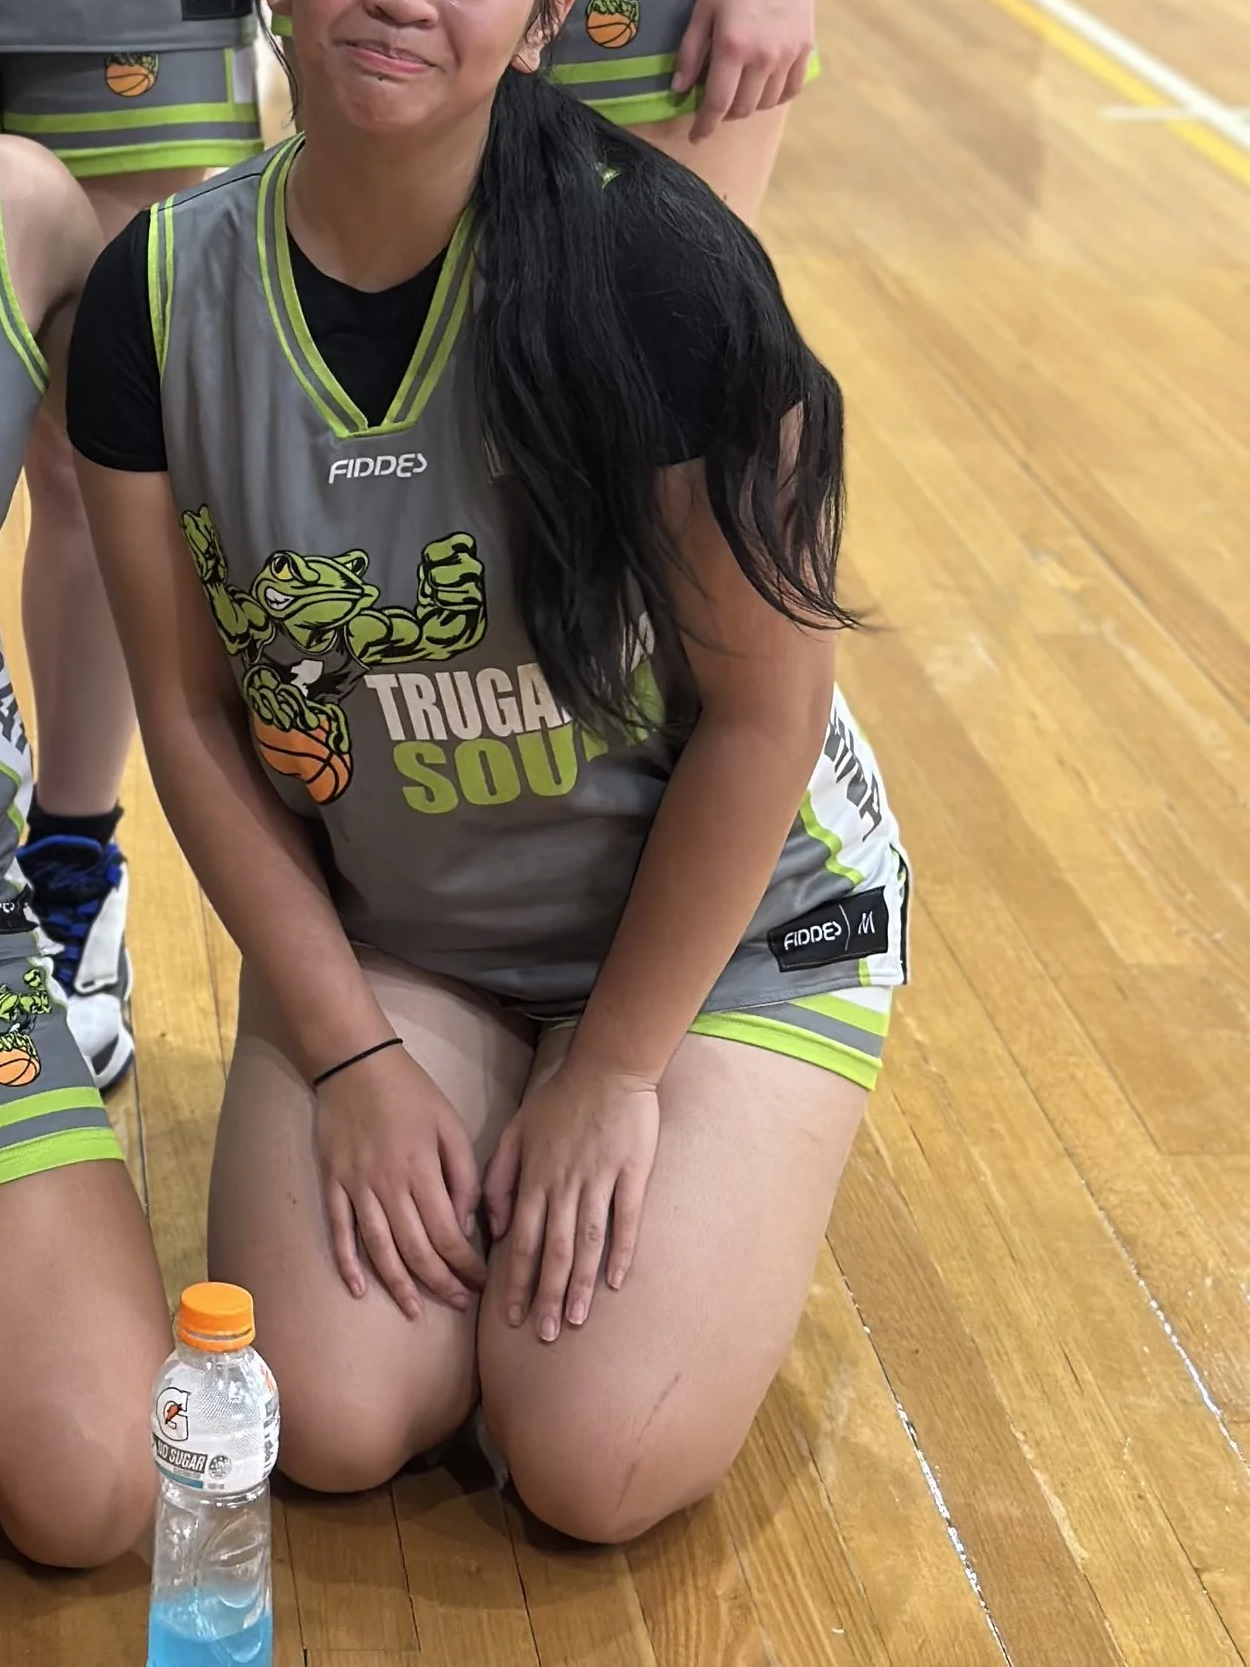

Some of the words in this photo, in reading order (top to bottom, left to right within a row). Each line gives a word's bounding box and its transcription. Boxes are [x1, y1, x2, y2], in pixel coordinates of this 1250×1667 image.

[363, 662, 573, 741] TRUGA
[393, 721, 608, 814] SOU
[858, 911, 875, 934] M
[169, 1447, 206, 1472] SUGAR
